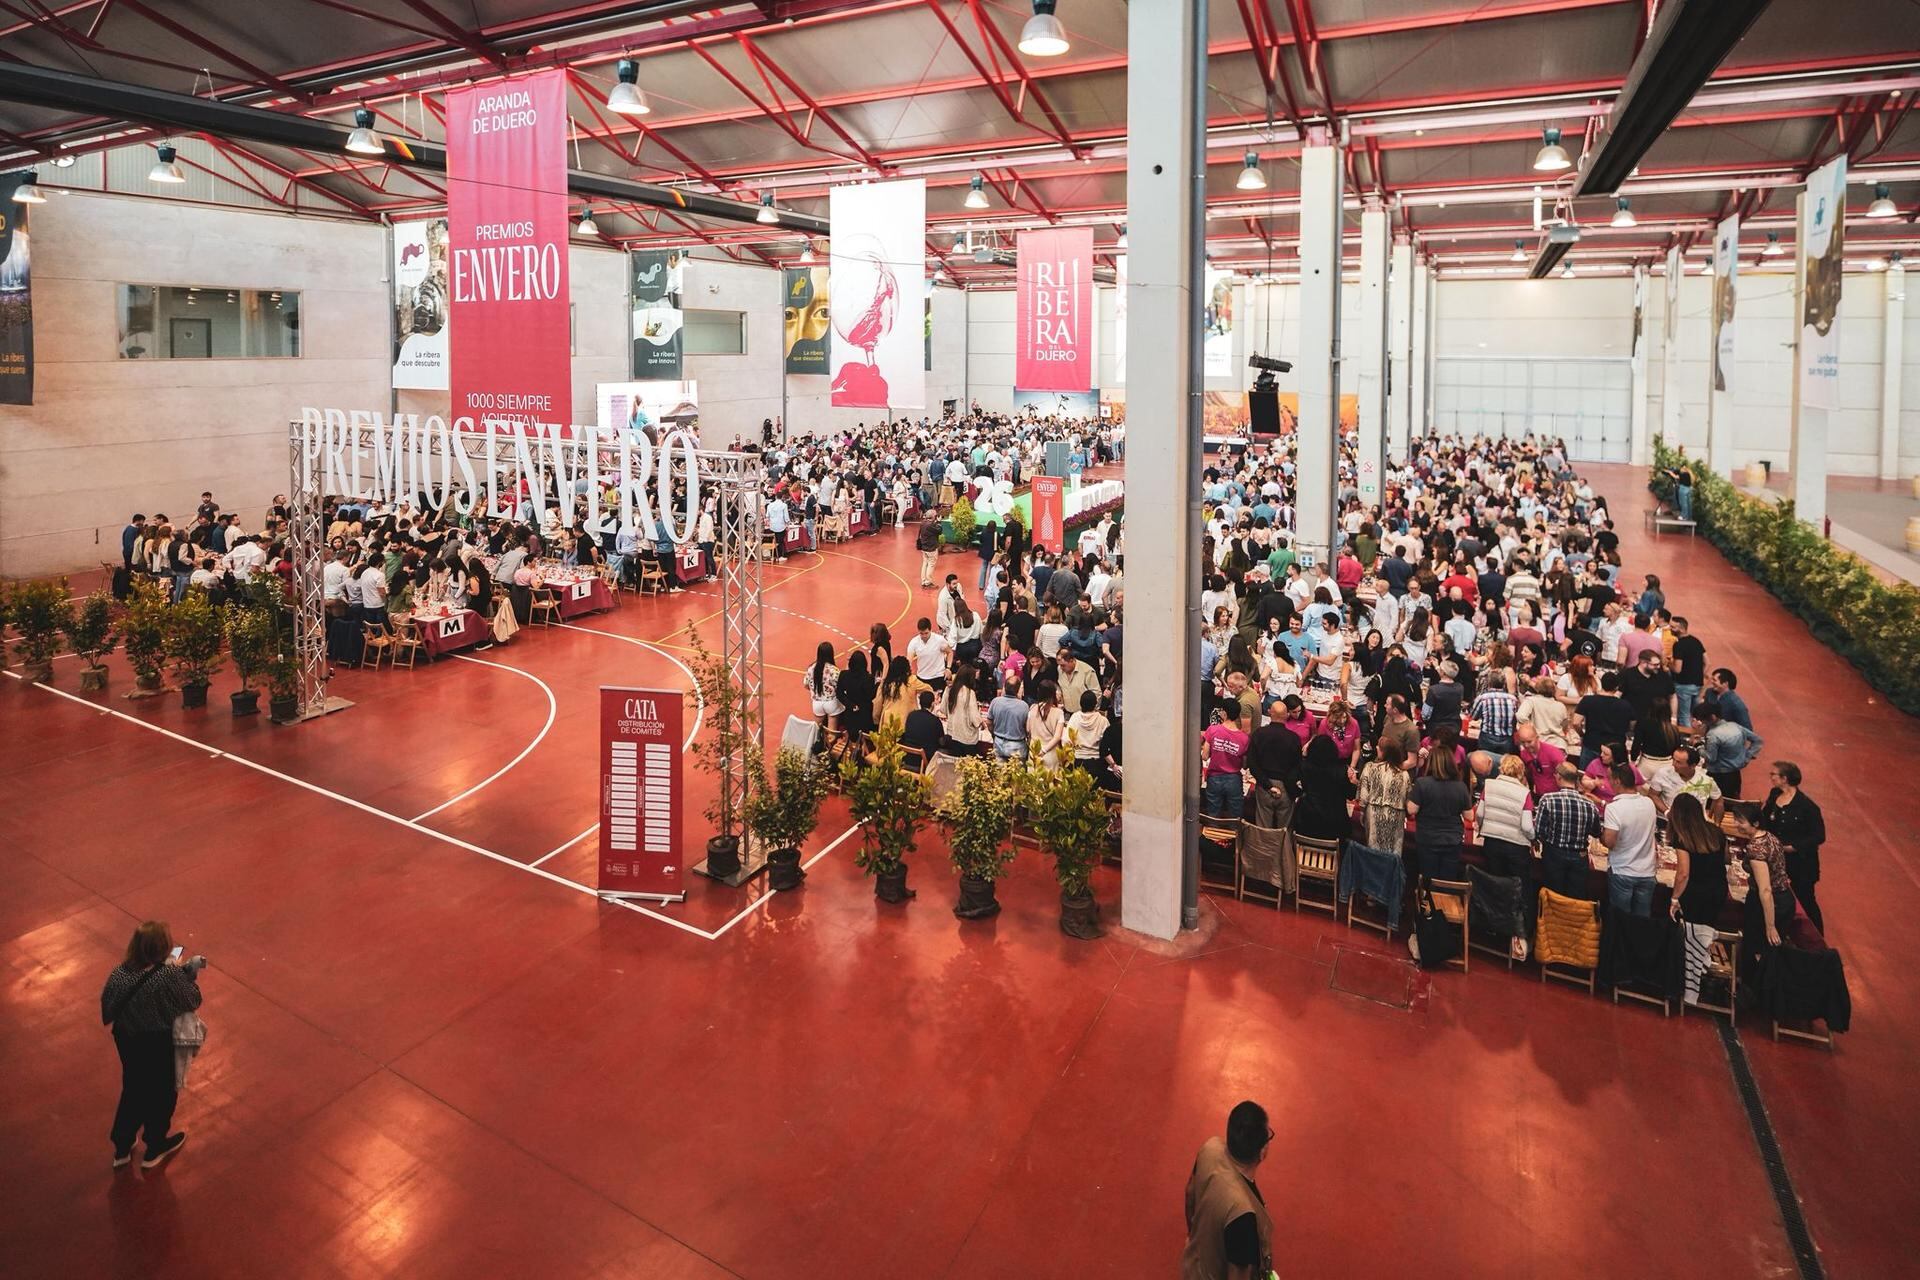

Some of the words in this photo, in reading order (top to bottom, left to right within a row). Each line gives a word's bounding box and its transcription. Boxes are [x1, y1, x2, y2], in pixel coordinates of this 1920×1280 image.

[478, 91, 531, 114] ARANDA
[473, 117, 489, 135] DE
[493, 110, 537, 131] DUERO
[476, 221, 534, 241] PREMIOS
[454, 243, 561, 302] ENVERO
[1036, 350, 1077, 361] DUERO
[466, 393, 494, 408] 1000
[497, 394, 552, 411] SIEMPRE
[302, 407, 479, 516] PREMIOS
[485, 418, 701, 545] ENVERO
[791, 530, 796, 540] J
[687, 556, 694, 567] K
[578, 586, 585, 597] L
[444, 619, 461, 635] M
[624, 698, 658, 721] CATA
